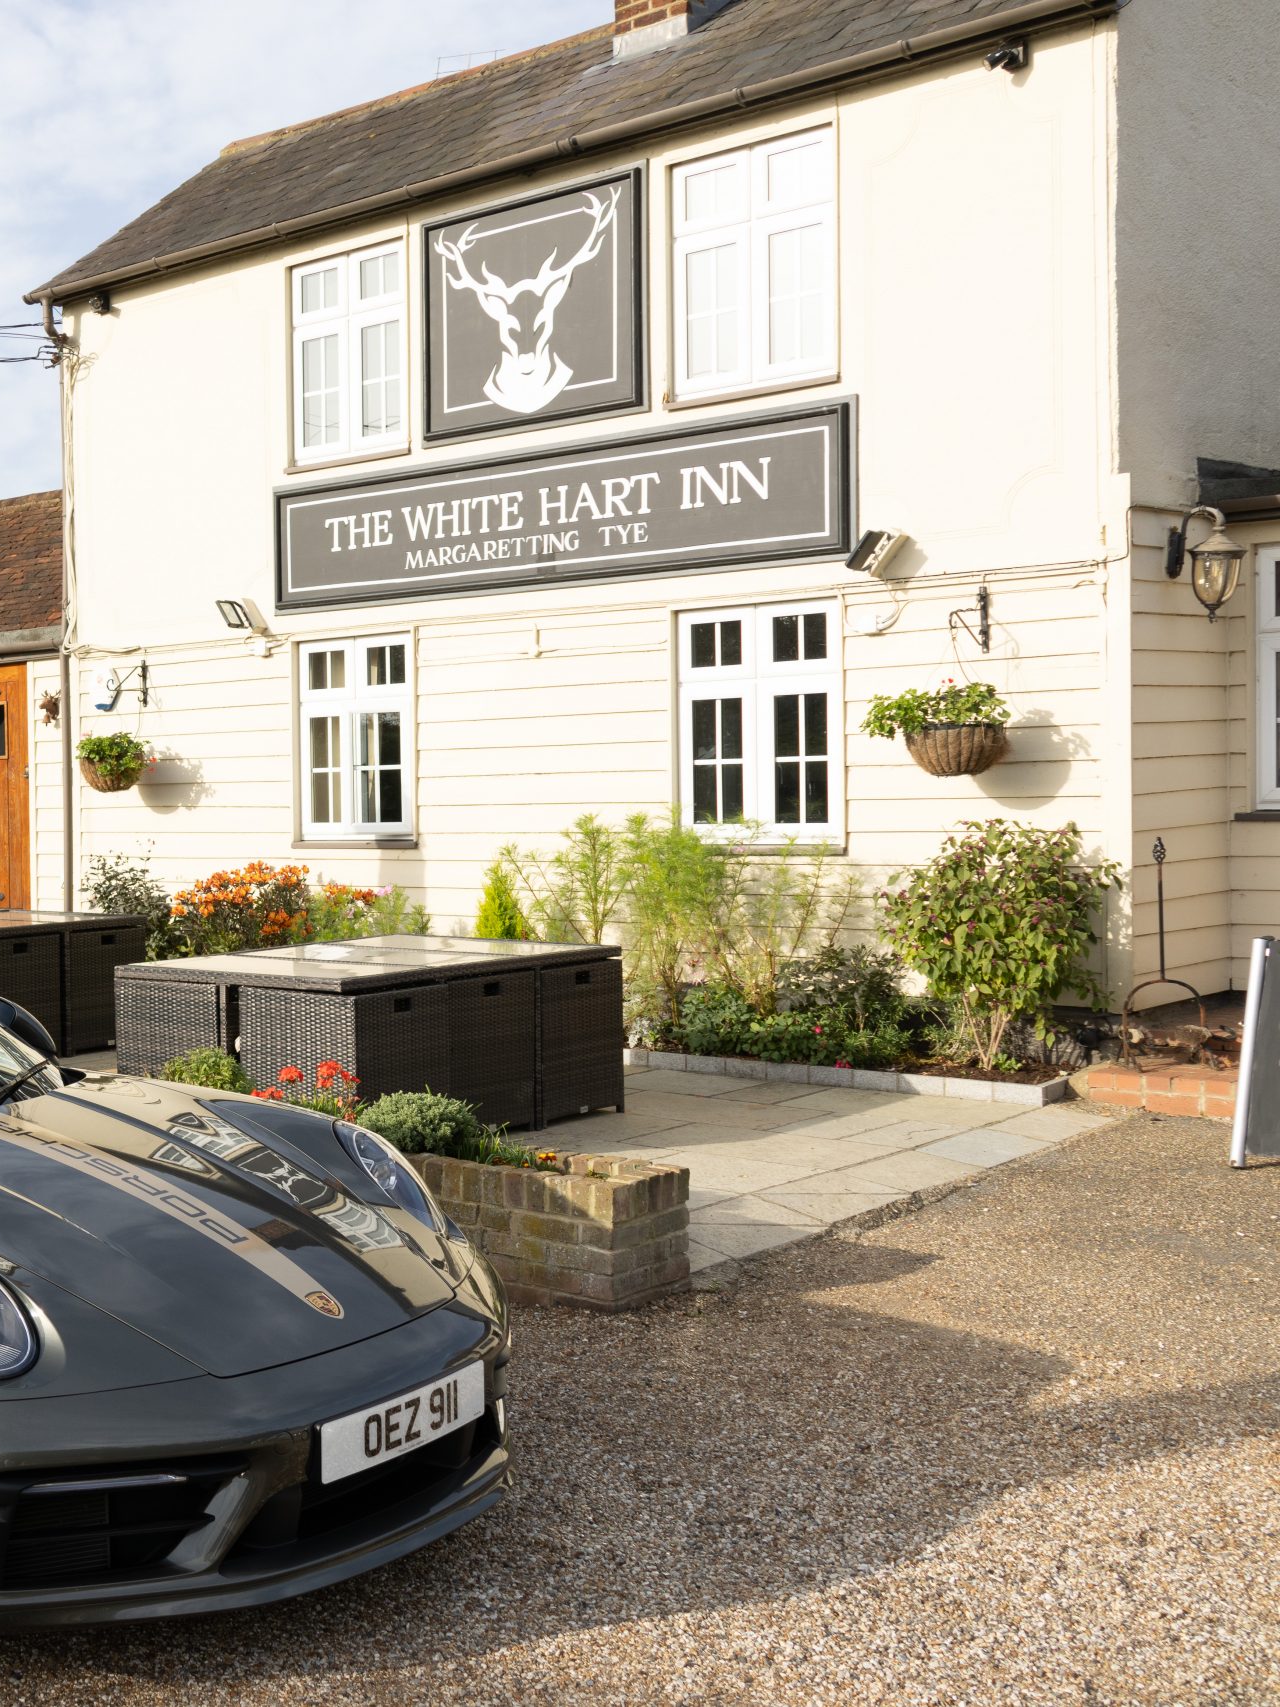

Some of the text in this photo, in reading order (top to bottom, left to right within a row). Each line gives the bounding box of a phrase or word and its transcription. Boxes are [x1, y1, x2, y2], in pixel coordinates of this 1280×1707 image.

[325, 457, 771, 552] THE WHITE HART INN
[404, 522, 648, 570] MARGARETTING TYE
[364, 1379, 458, 1458] OEZ 911
